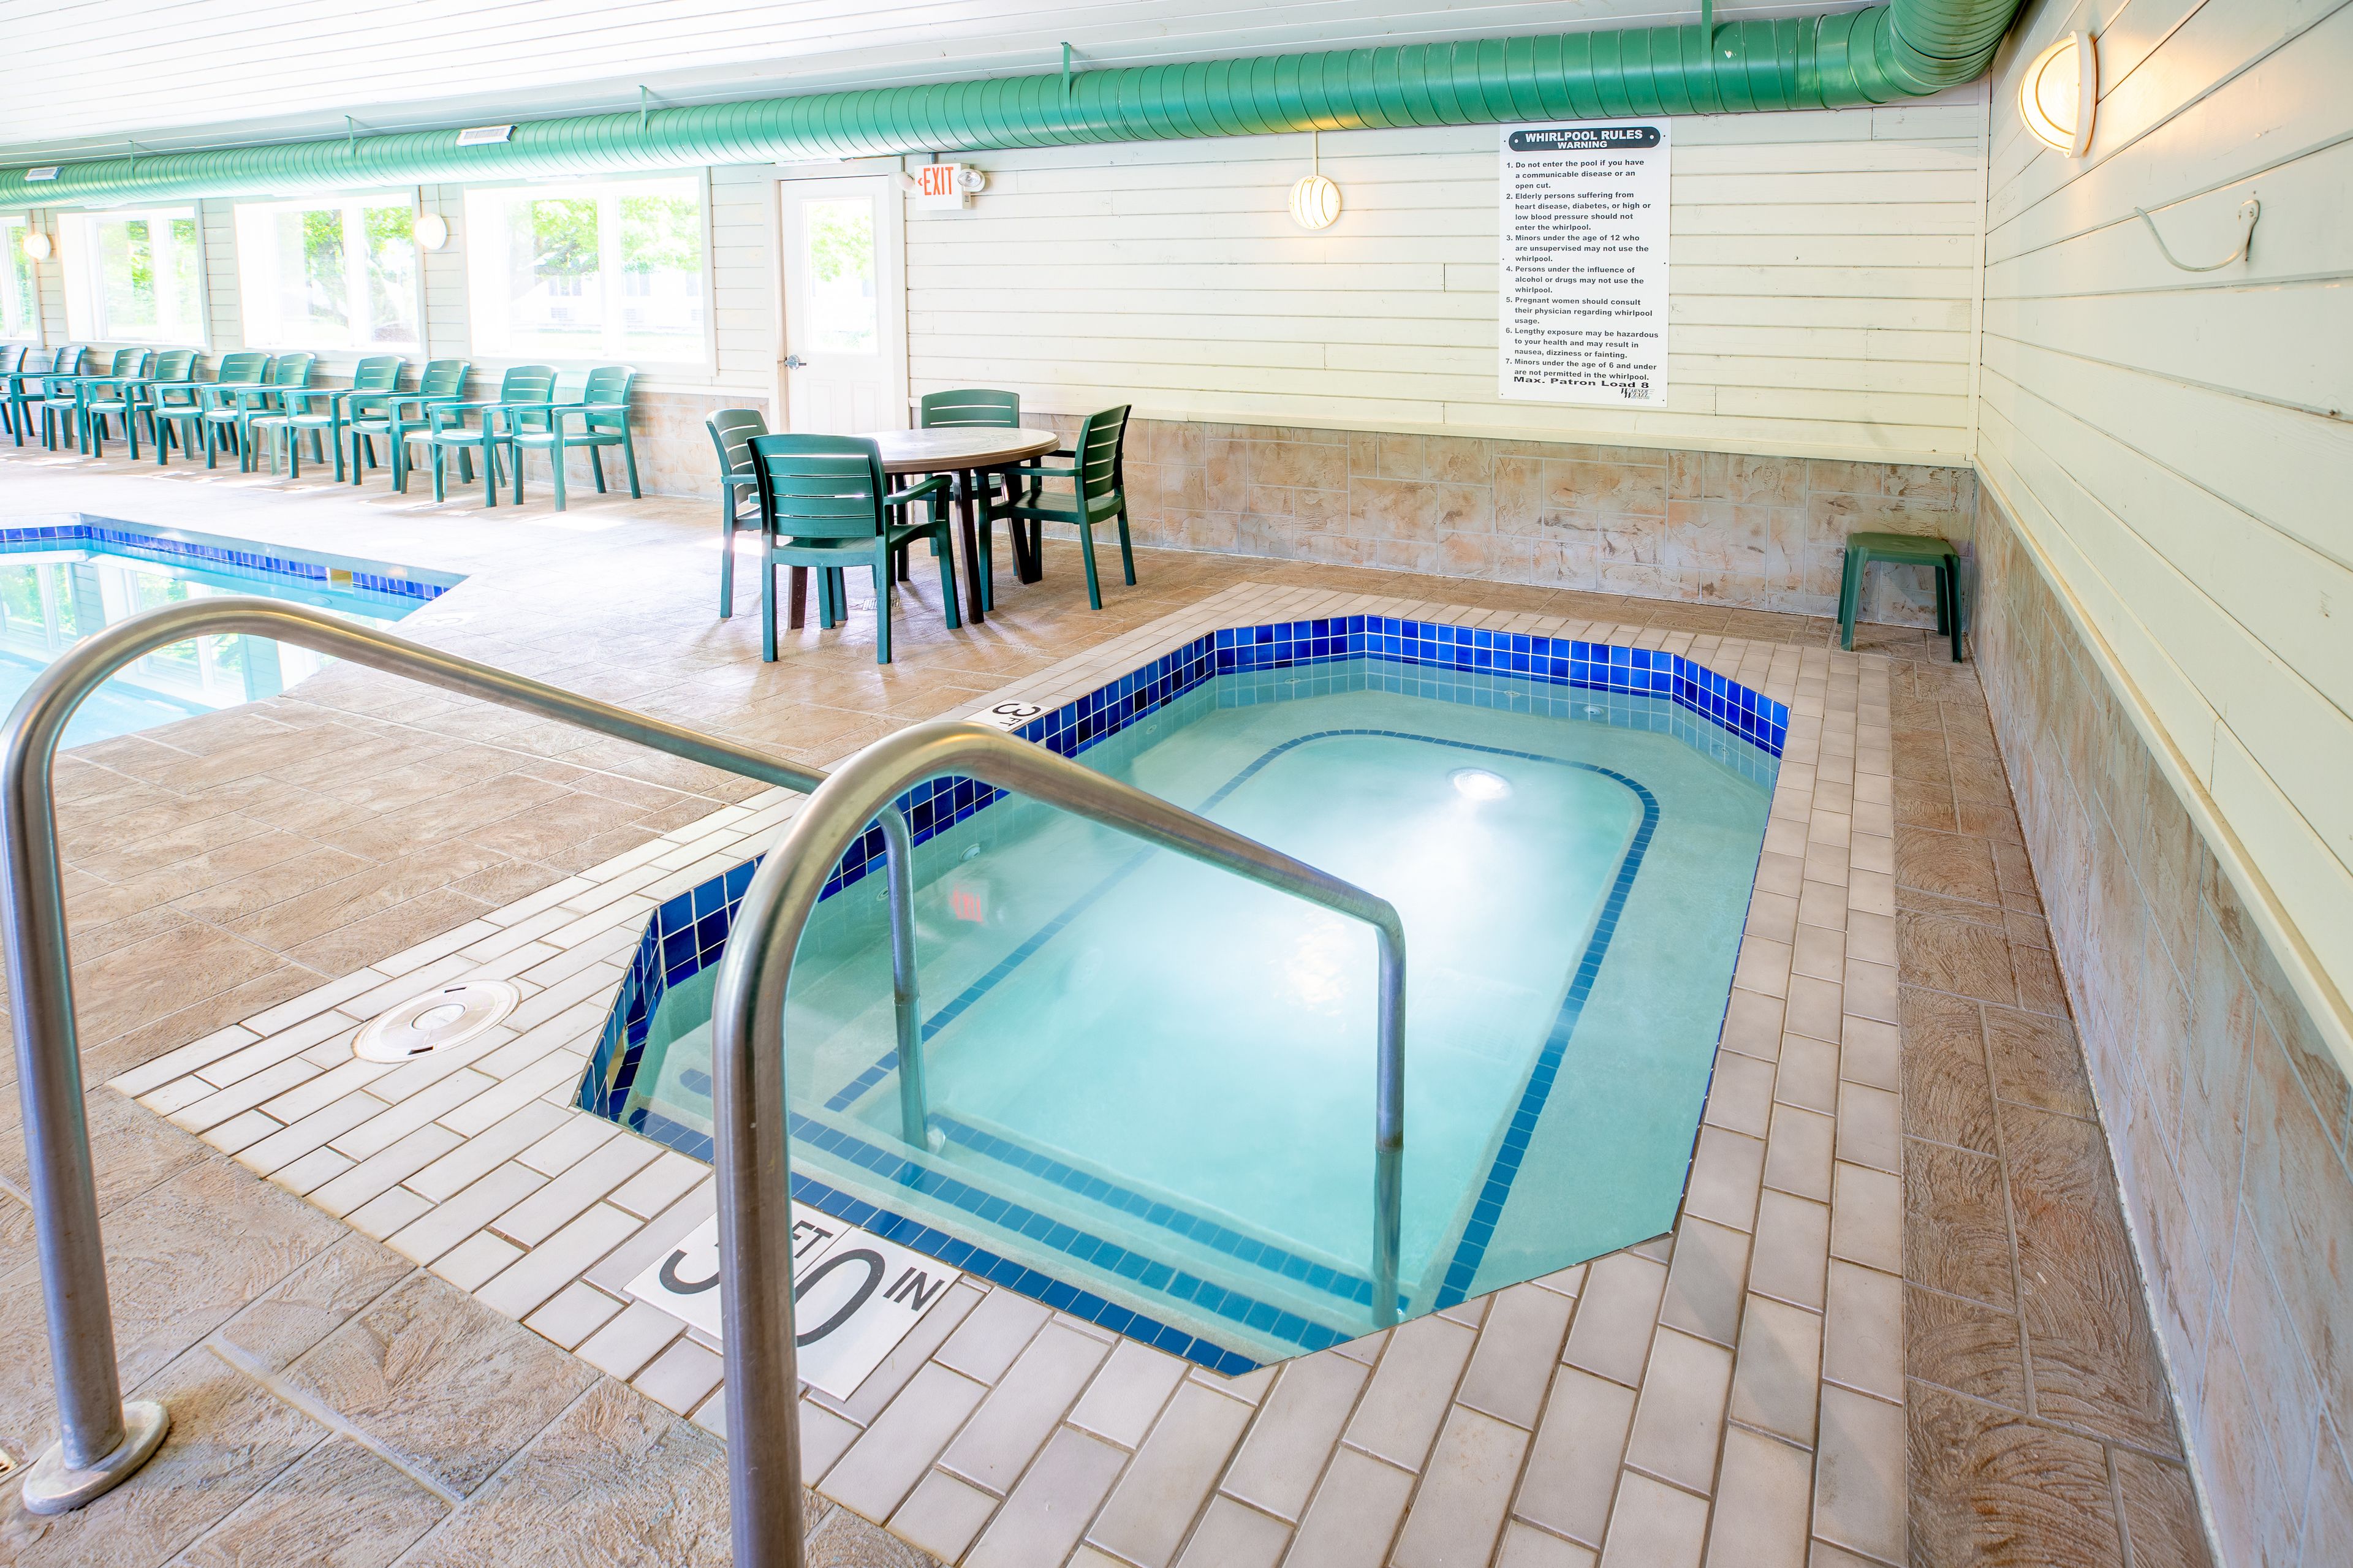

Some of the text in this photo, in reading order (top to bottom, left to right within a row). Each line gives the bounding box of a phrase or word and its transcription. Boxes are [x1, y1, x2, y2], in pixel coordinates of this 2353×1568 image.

[1525, 129, 1643, 142] WHIRLPOOL RULES
[923, 167, 954, 195] EXIT
[1594, 351, 1627, 360] fainting.
[992, 703, 1041, 727] 3 FT
[882, 1267, 945, 1312] IN
